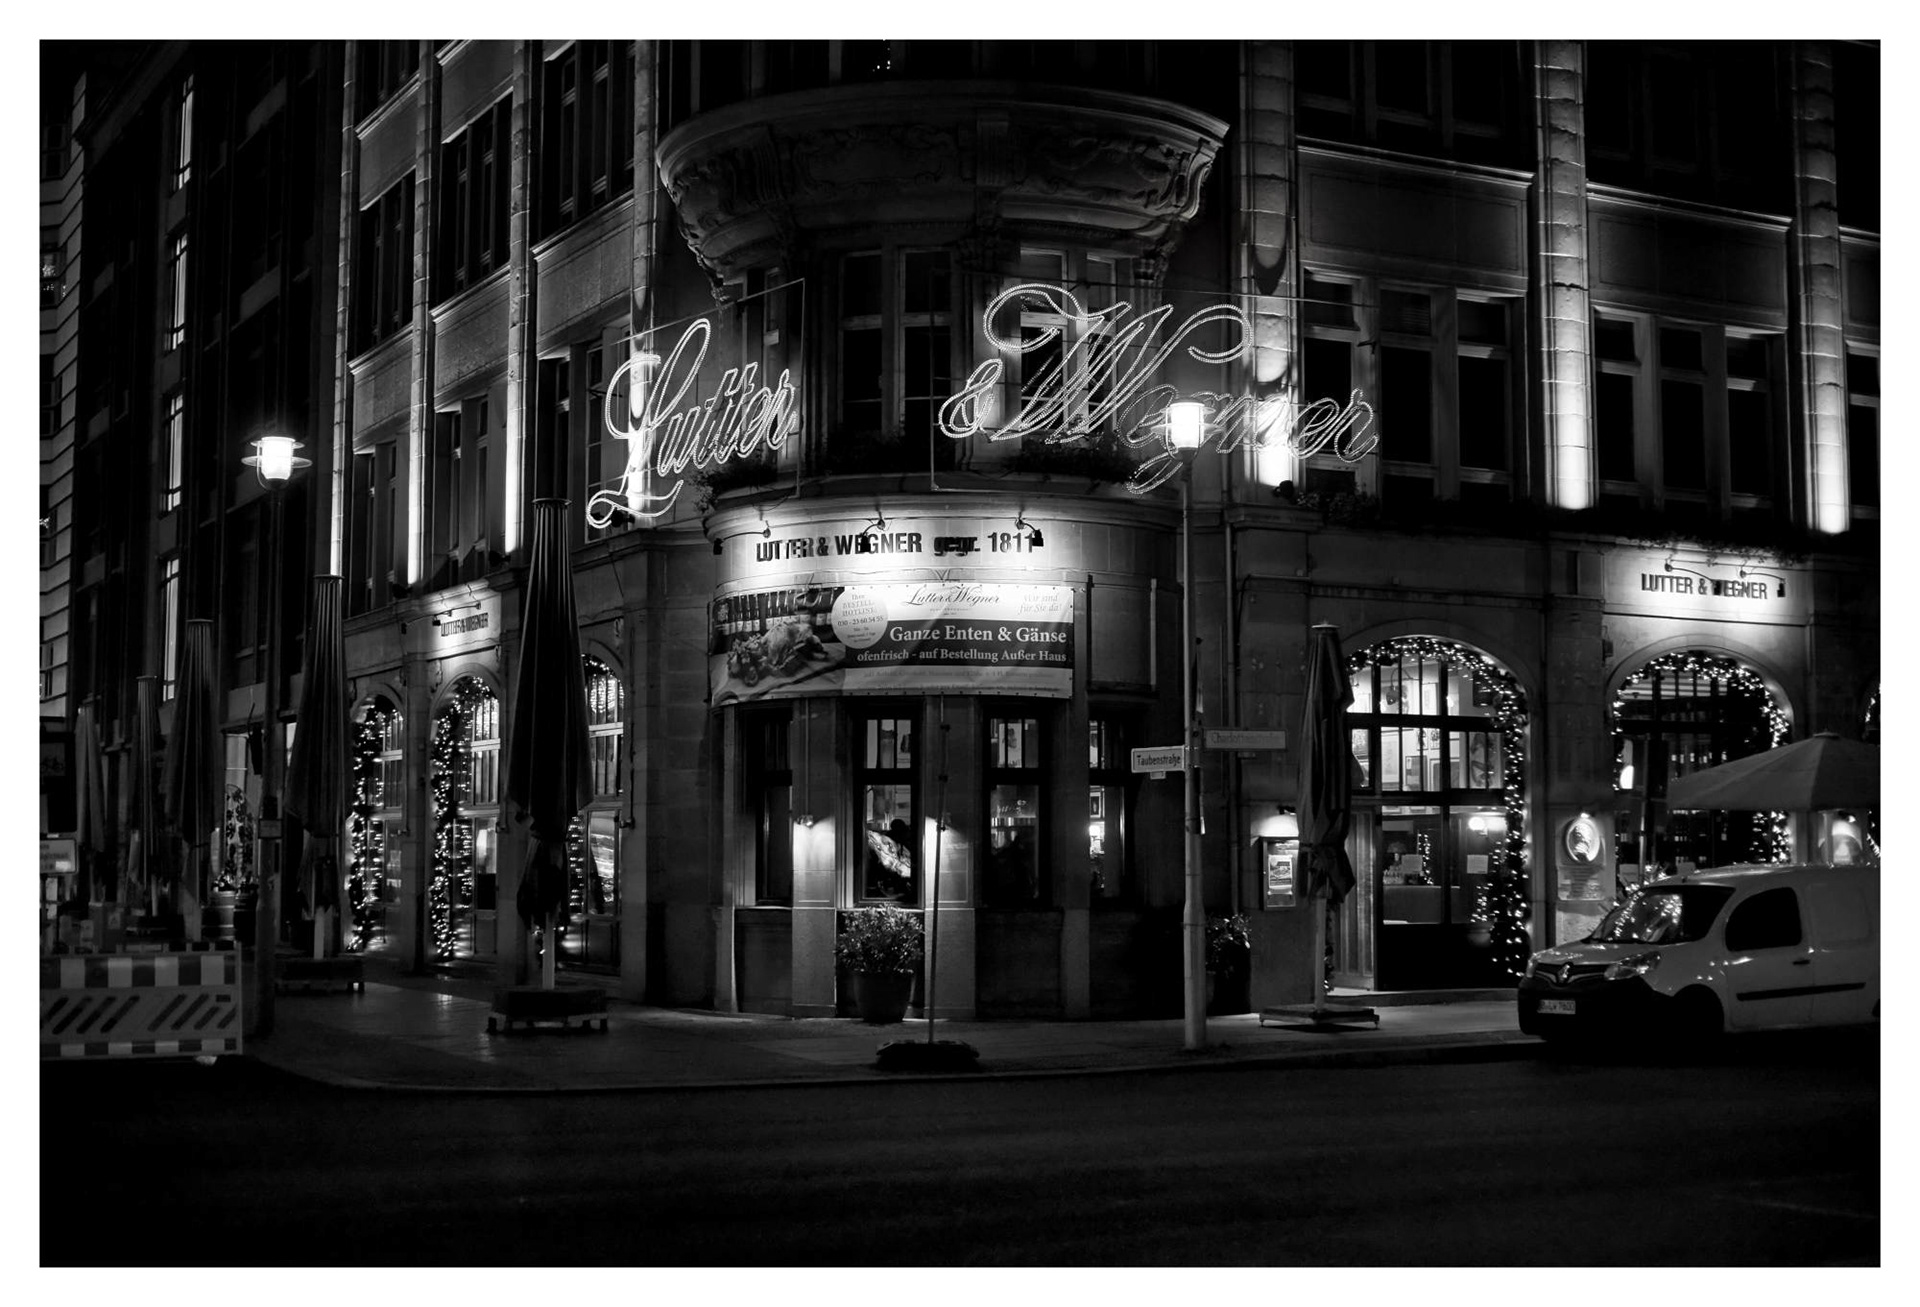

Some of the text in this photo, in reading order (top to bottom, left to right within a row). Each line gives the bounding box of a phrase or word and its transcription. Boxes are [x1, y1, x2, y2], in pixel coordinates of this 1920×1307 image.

[586, 317, 798, 529] Lutter
[938, 357, 1003, 438] &
[816, 536, 830, 557] &
[1641, 572, 1693, 595] LUTTER
[1697, 577, 1708, 596] &
[889, 623, 941, 643] Ganze
[944, 624, 993, 642] Enten
[997, 626, 1012, 643] &
[1016, 627, 1068, 644] Gänse
[856, 648, 910, 663] ofenfrisch
[919, 648, 938, 660] auf
[940, 648, 999, 663] Bestellung
[1000, 649, 1036, 662] Außer
[1039, 650, 1068, 663] Haus
[1136, 753, 1181, 767] Taubenstraße
